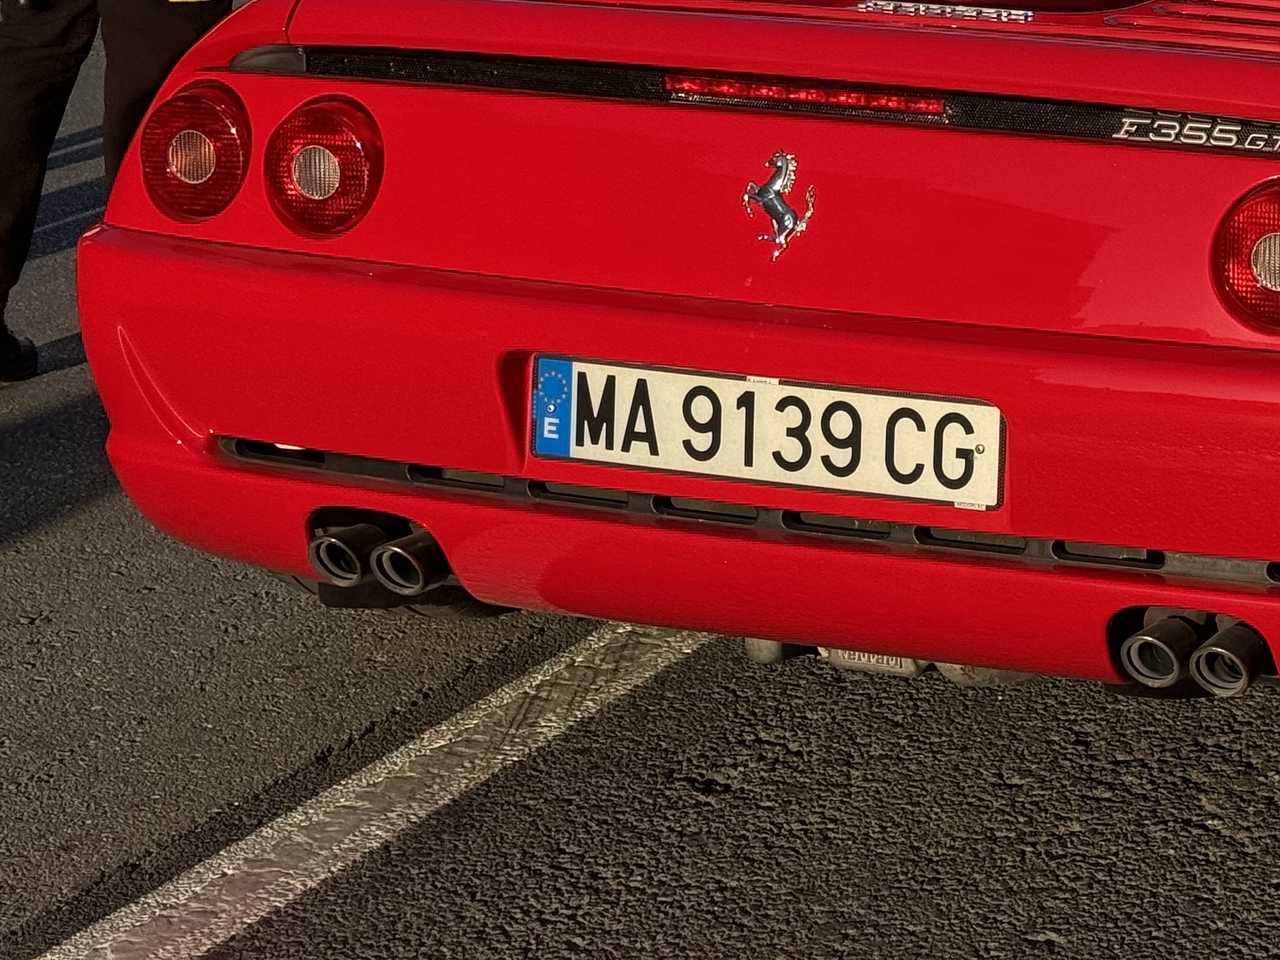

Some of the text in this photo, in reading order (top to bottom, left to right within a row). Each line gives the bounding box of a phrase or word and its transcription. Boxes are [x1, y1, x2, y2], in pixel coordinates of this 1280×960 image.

[1112, 118, 1242, 147] F355
[543, 416, 560, 439] E
[575, 371, 975, 489] MA 9139 CG
